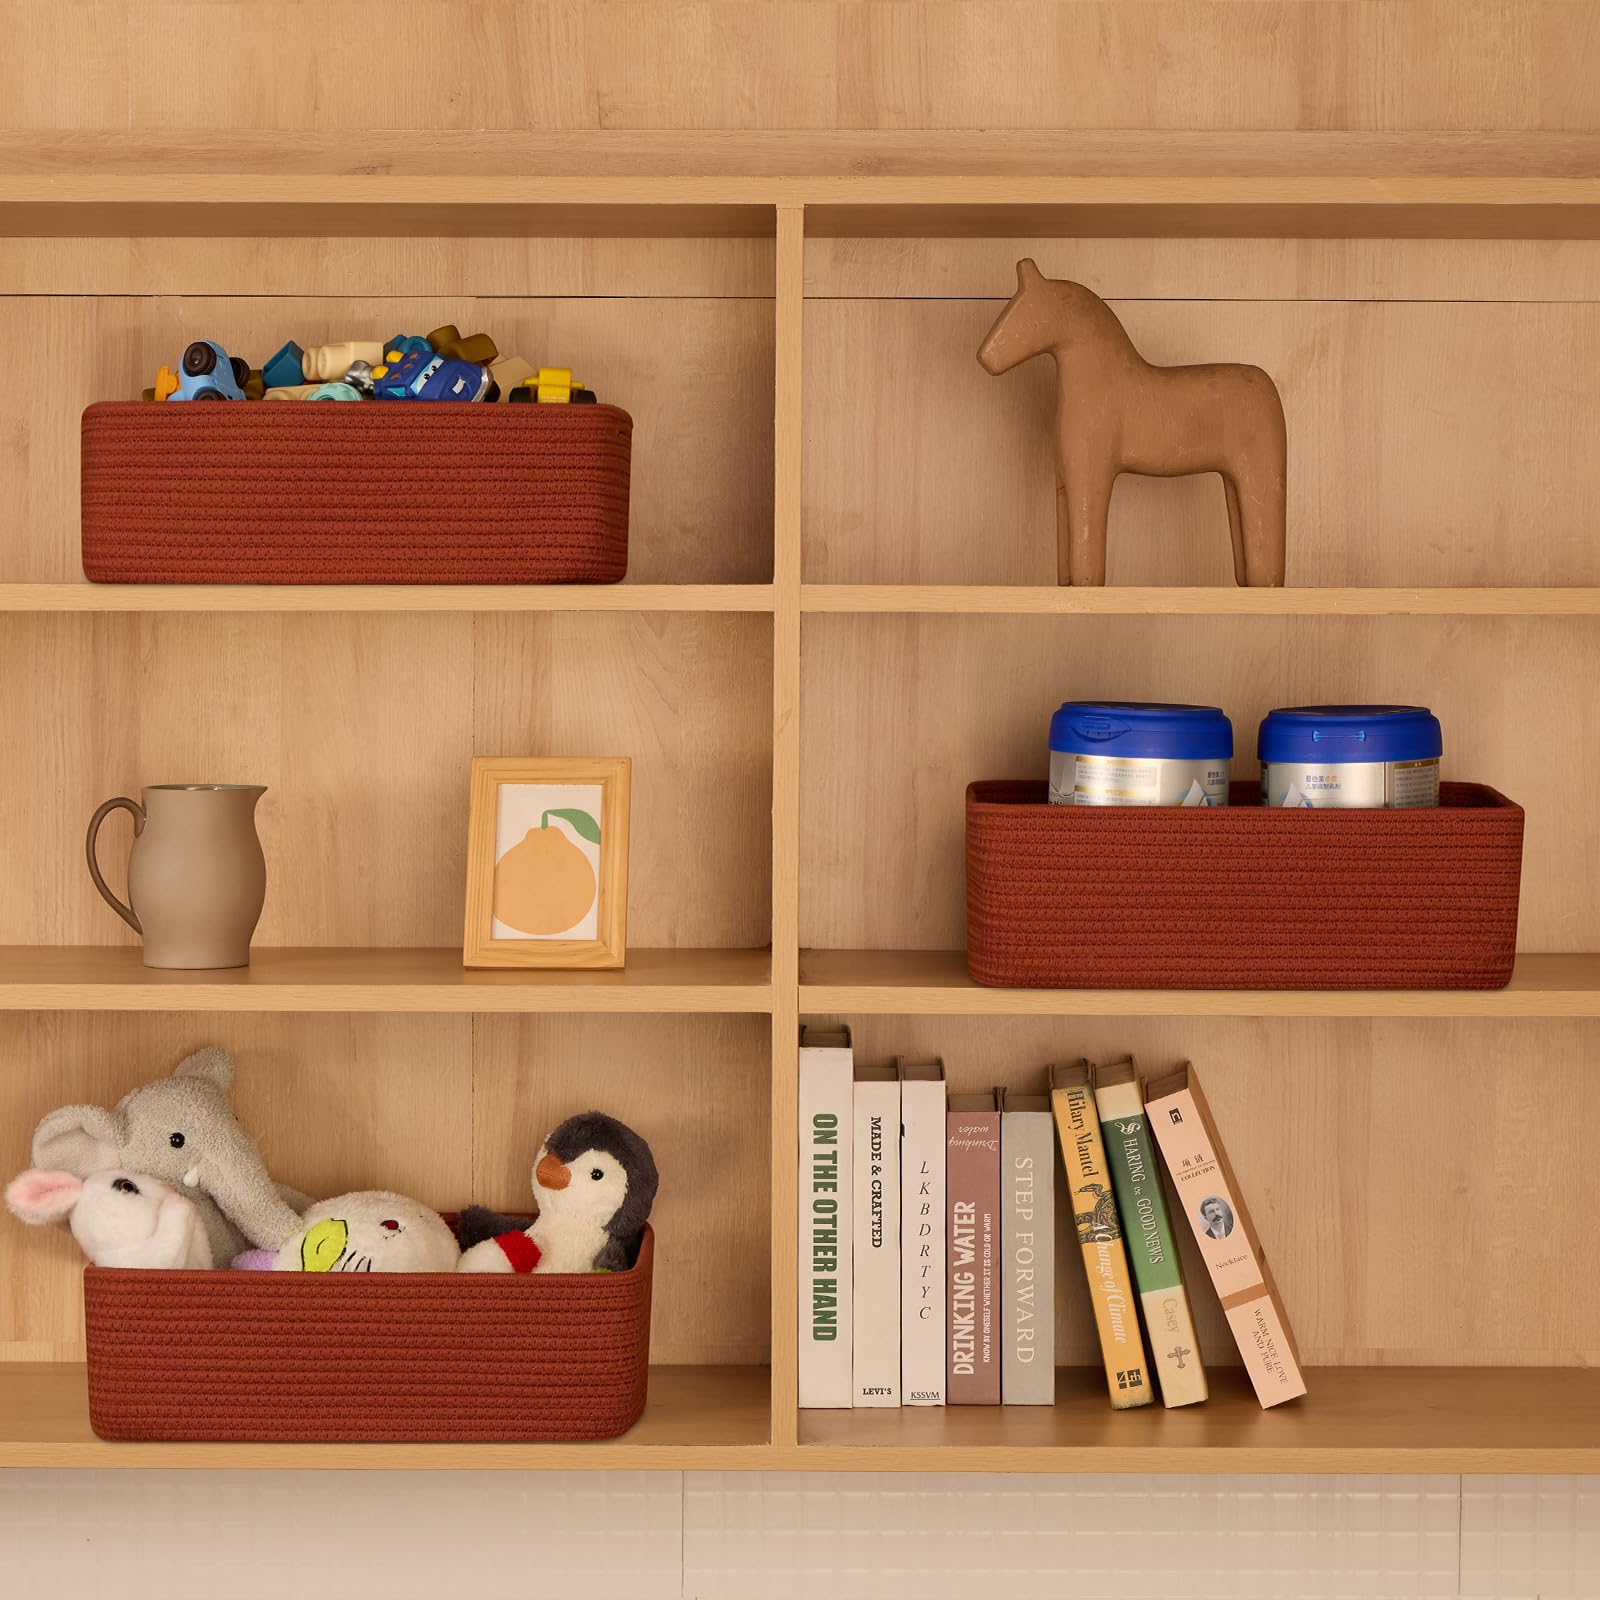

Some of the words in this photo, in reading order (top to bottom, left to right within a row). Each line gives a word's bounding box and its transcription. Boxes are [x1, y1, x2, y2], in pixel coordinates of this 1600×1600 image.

[1067, 1090, 1087, 1131] Hilary
[812, 1113, 838, 1144] ON
[870, 1116, 883, 1162] MADE
[949, 1136, 999, 1151] Drinking
[958, 1126, 989, 1137] water
[870, 1165, 882, 1176] &
[1075, 1132, 1099, 1178] Mantel
[812, 1150, 838, 1193] THE
[1181, 1165, 1216, 1182] COLLECTION
[1015, 1156, 1034, 1221] STEP
[871, 1179, 883, 1249] CRAFTED
[1093, 1221, 1106, 1233] A
[1136, 1198, 1156, 1235] GOOD
[812, 1199, 838, 1272] OTHER
[953, 1201, 976, 1267] WATER
[984, 1233, 991, 1243] OR
[1144, 1233, 1164, 1265] NEWS
[983, 1258, 991, 1267] IS
[983, 1268, 991, 1277] IT
[1095, 1233, 1114, 1280] Change
[1215, 1254, 1249, 1270] Necklace
[983, 1277, 991, 1305] WHETHER
[1015, 1231, 1035, 1364] FORWARD
[1101, 1280, 1122, 1297] of
[812, 1278, 838, 1341] HAND
[953, 1272, 975, 1375] DRINKING
[983, 1305, 991, 1334] ONESELF
[1107, 1295, 1128, 1344] Climate
[1162, 1298, 1180, 1333] Casey
[983, 1334, 991, 1344] BY
[983, 1345, 991, 1363] KNOW
[1252, 1330, 1265, 1349] AND
[1260, 1351, 1275, 1374] PURE
[1254, 1308, 1270, 1337] WARM
[1265, 1338, 1279, 1360] NICE
[1274, 1361, 1289, 1385] LOVE
[862, 1387, 892, 1396] LEVI'S
[911, 1391, 940, 1399] KSSVM
